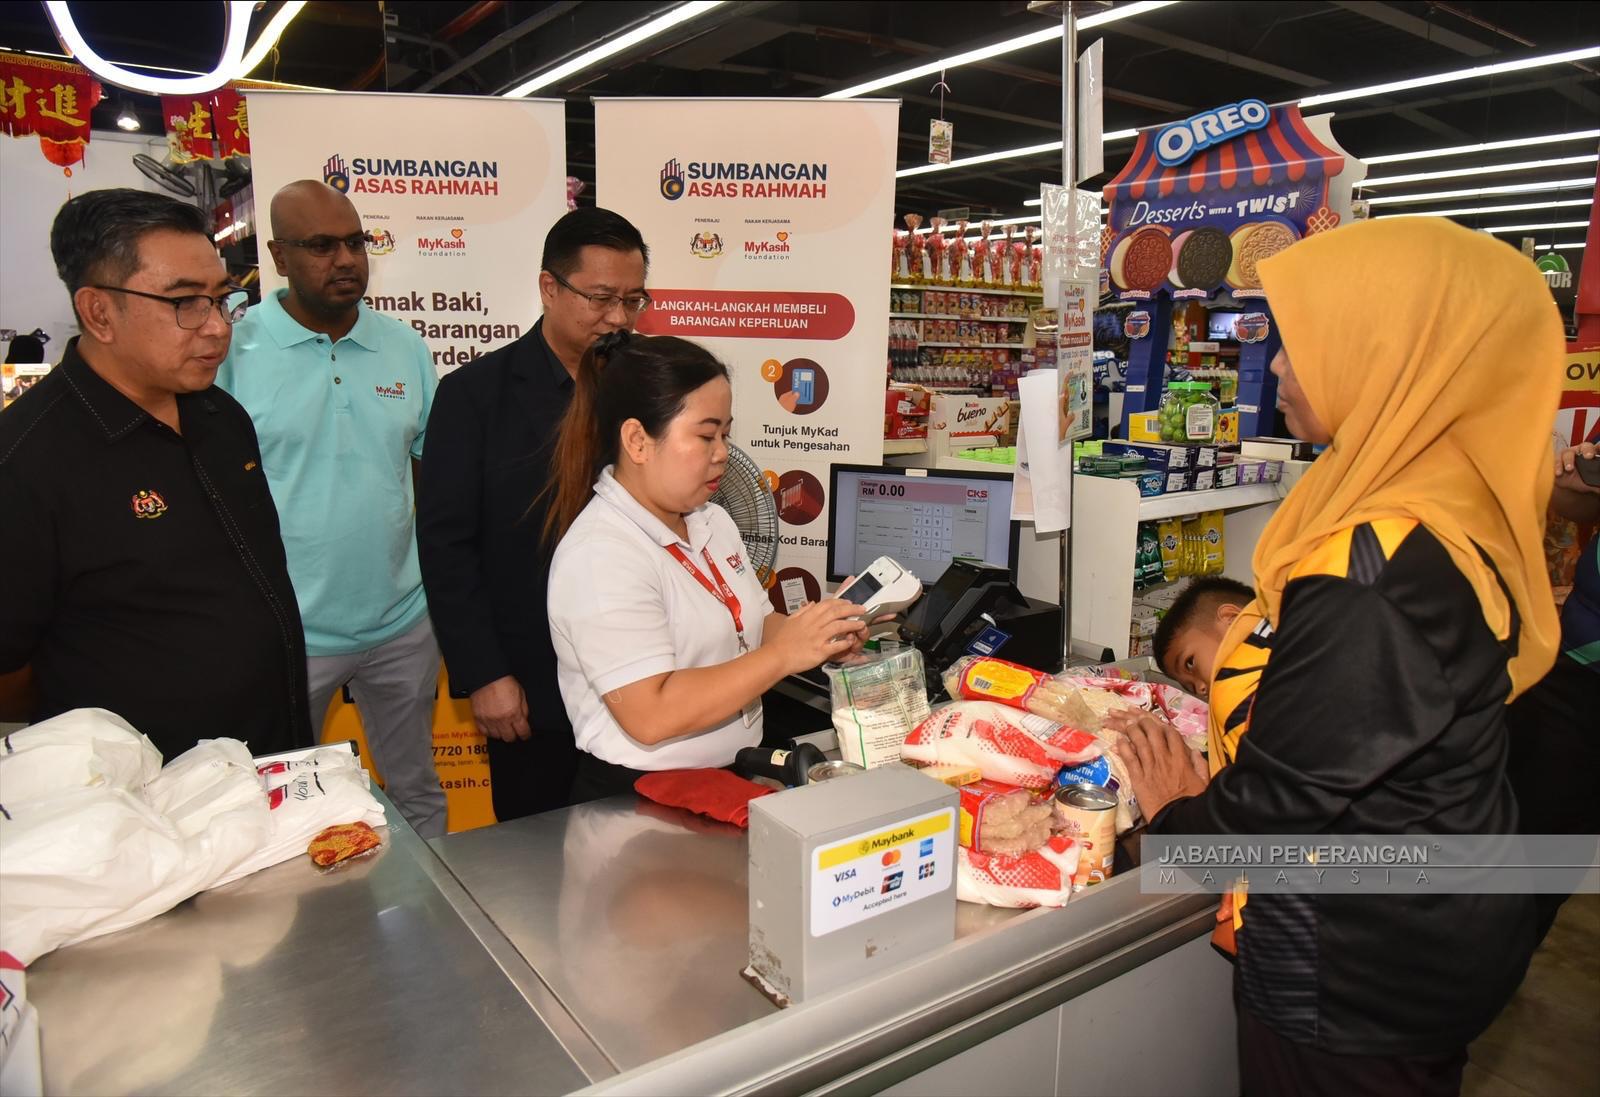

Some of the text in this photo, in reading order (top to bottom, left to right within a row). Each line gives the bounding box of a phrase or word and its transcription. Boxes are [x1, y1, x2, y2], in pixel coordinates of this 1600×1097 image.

[1157, 101, 1267, 161] OREO
[352, 158, 498, 178] SUMBANGAN
[687, 162, 827, 181] SUMBANGAN
[354, 177, 499, 196] ASAS RAHMAH
[687, 182, 827, 199] ASAS RAHMAH
[1129, 200, 1207, 227] Desserts
[1208, 207, 1227, 216] WITH
[1236, 191, 1300, 218] TWIST
[417, 237, 466, 251] MyKasih
[744, 241, 790, 254] MyKasih
[431, 291, 489, 316] Baki,
[653, 300, 827, 315] LANGKAH-LANGKAH MEMBELI
[670, 315, 809, 329] BARANGAN KEPERLUAN
[411, 319, 520, 344] Barangan
[432, 346, 492, 366] rdek
[956, 407, 987, 423] bueno
[763, 424, 839, 438] Tunjuk MyKad
[750, 439, 850, 452] untuk Pengesahan
[862, 484, 905, 497] RM 0.00
[967, 489, 988, 498] CKS
[777, 535, 797, 545] Kod
[431, 744, 488, 757] 7720 180
[871, 828, 915, 849] Maybank
[833, 867, 857, 883] VISA
[841, 886, 875, 904] MyDebit
[862, 891, 907, 912] Accepted here
